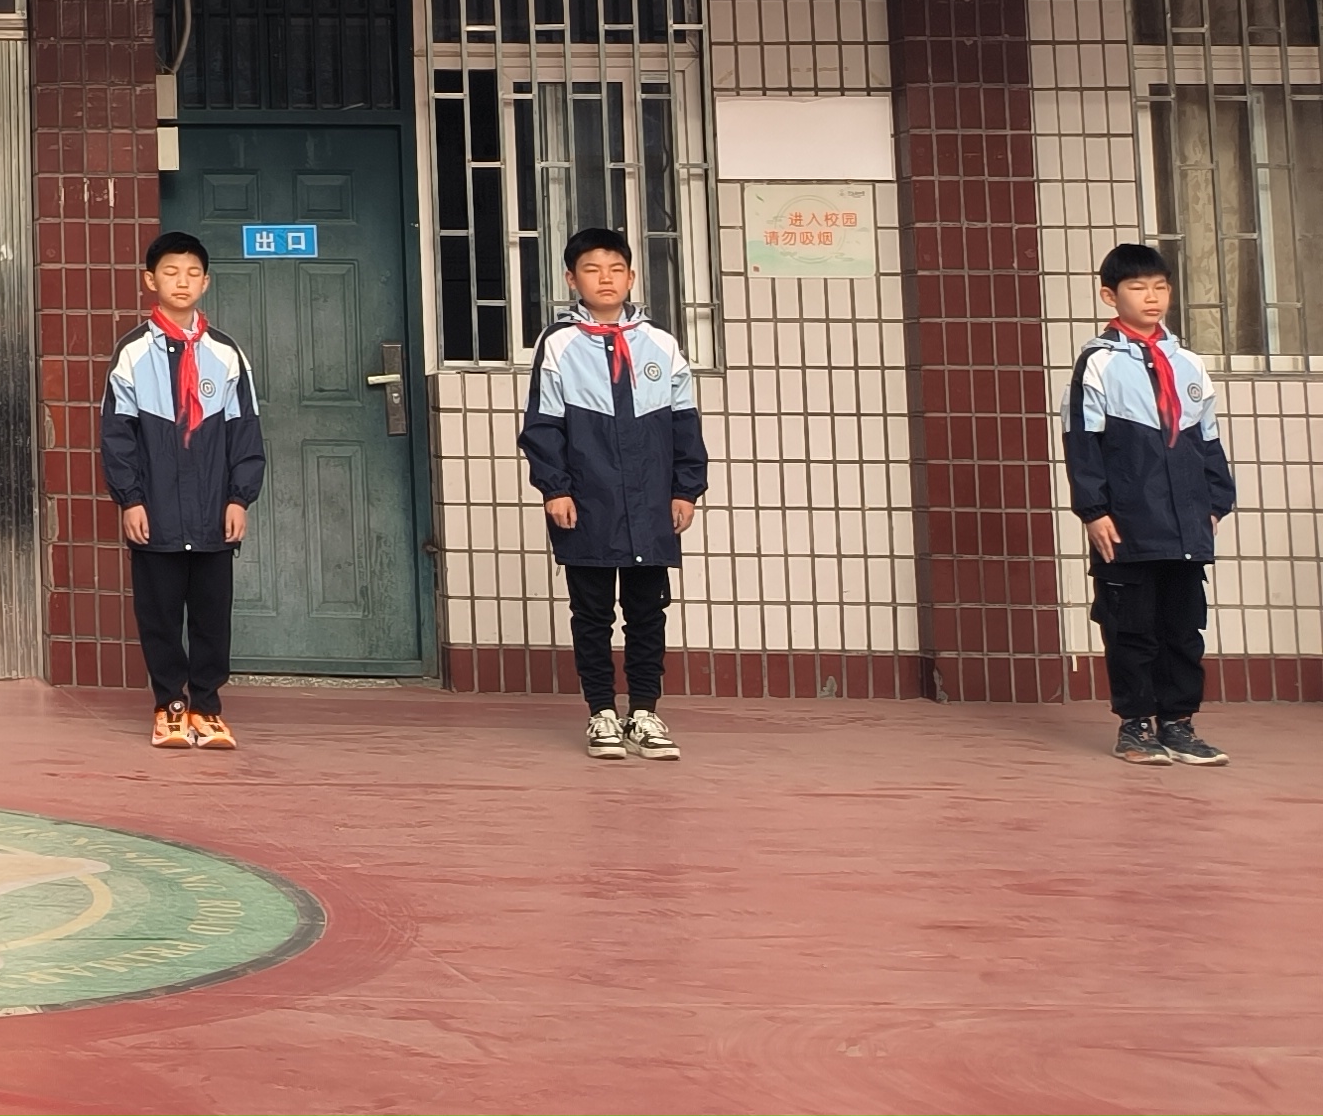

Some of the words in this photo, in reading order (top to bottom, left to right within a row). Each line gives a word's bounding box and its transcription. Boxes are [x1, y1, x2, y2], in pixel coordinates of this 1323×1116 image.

[788, 211, 858, 228] 进入校园
[255, 230, 306, 252] 出口
[764, 230, 833, 246] 请勿吸烟
[186, 898, 246, 936] ROAD
